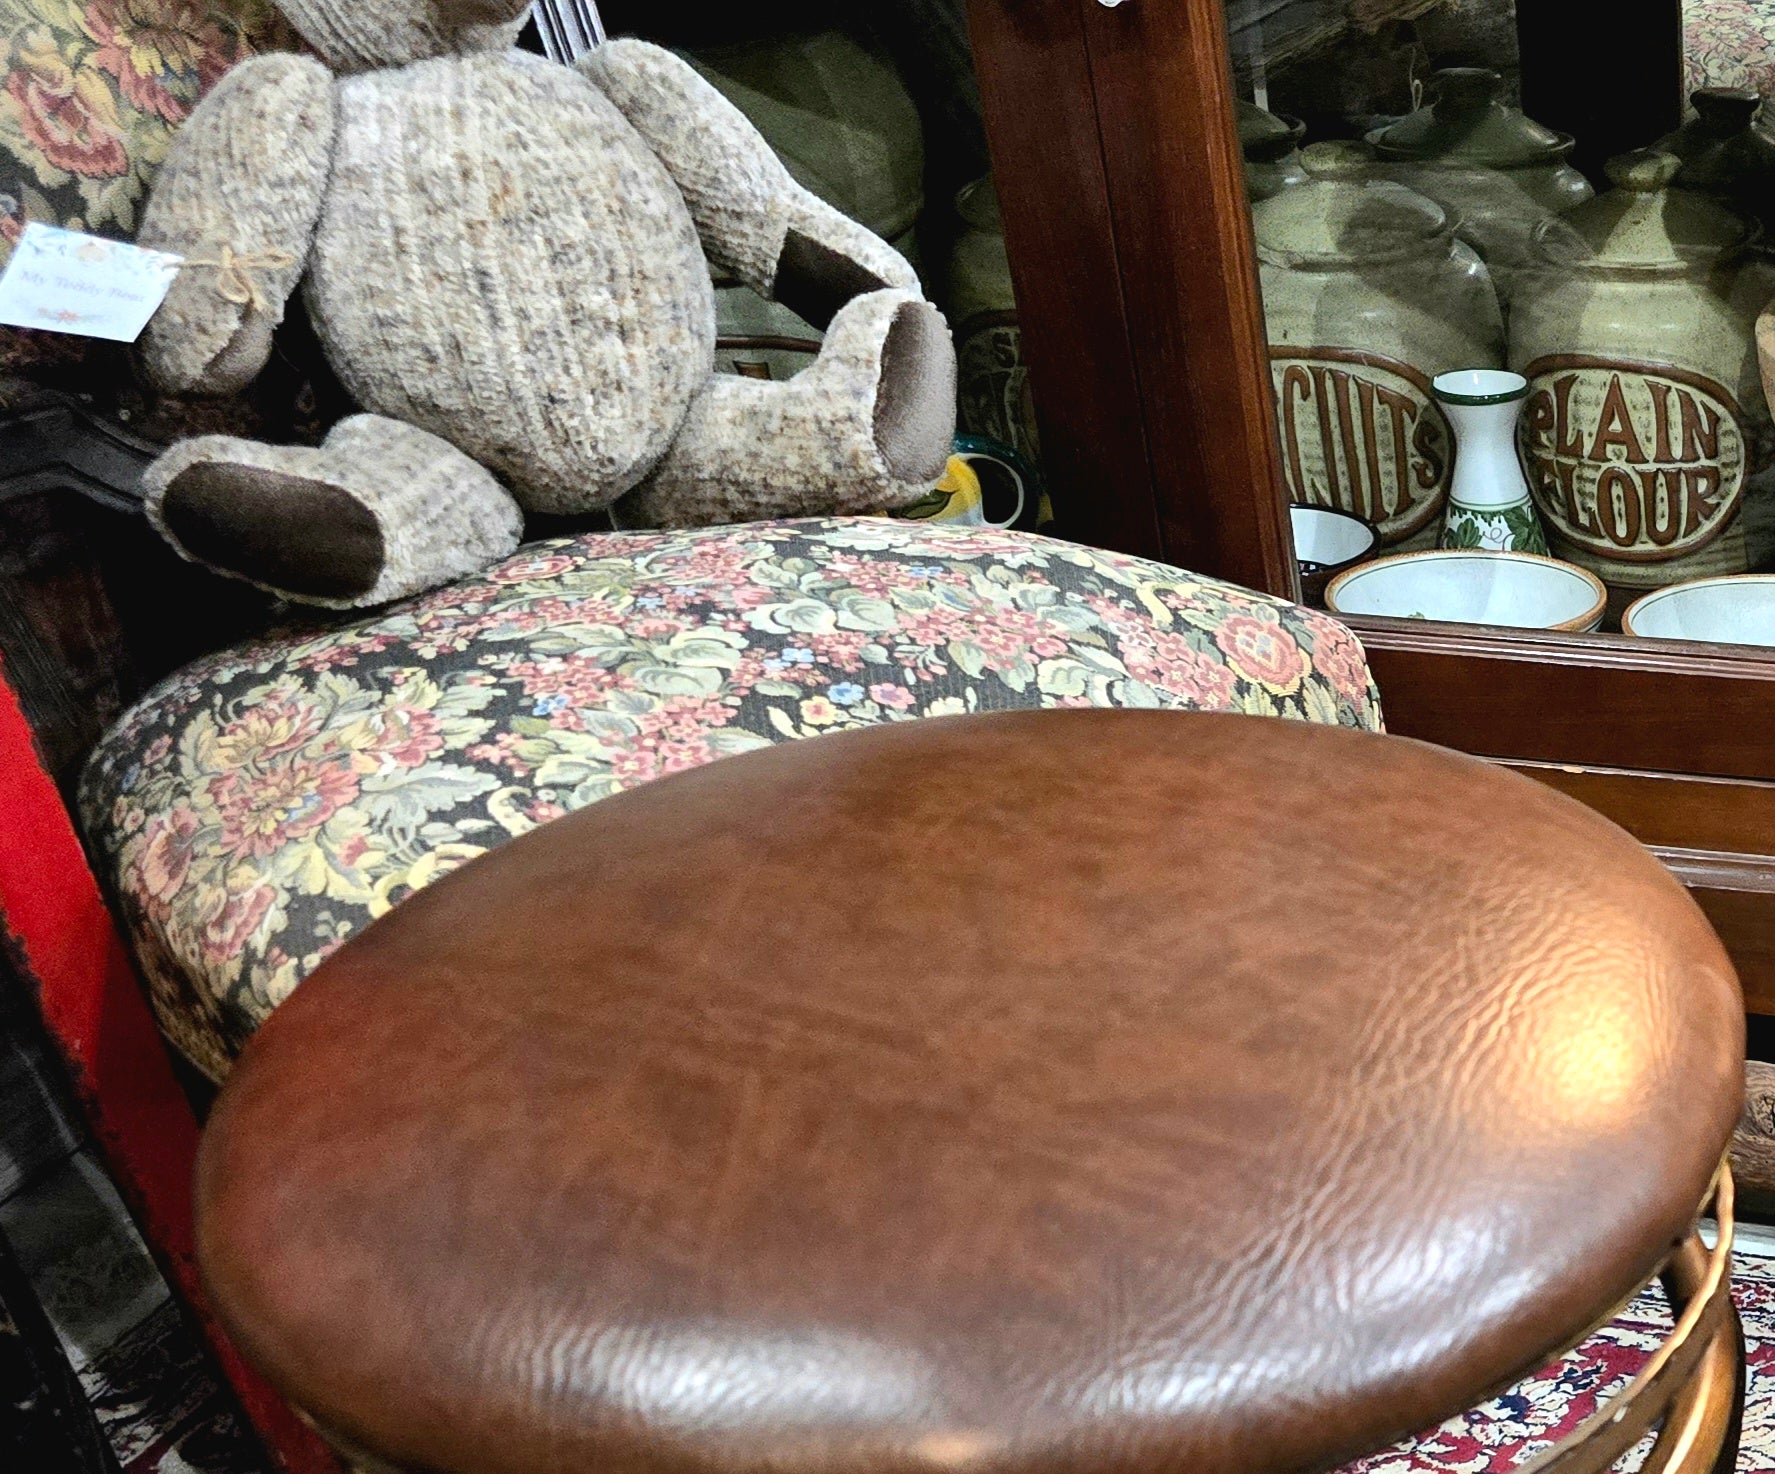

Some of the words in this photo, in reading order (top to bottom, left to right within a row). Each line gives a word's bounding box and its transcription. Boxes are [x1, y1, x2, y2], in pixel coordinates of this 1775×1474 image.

[1282, 364, 1444, 526] CUITS
[1529, 372, 1721, 464] PLAIN
[1532, 457, 1722, 547] FLOUR
